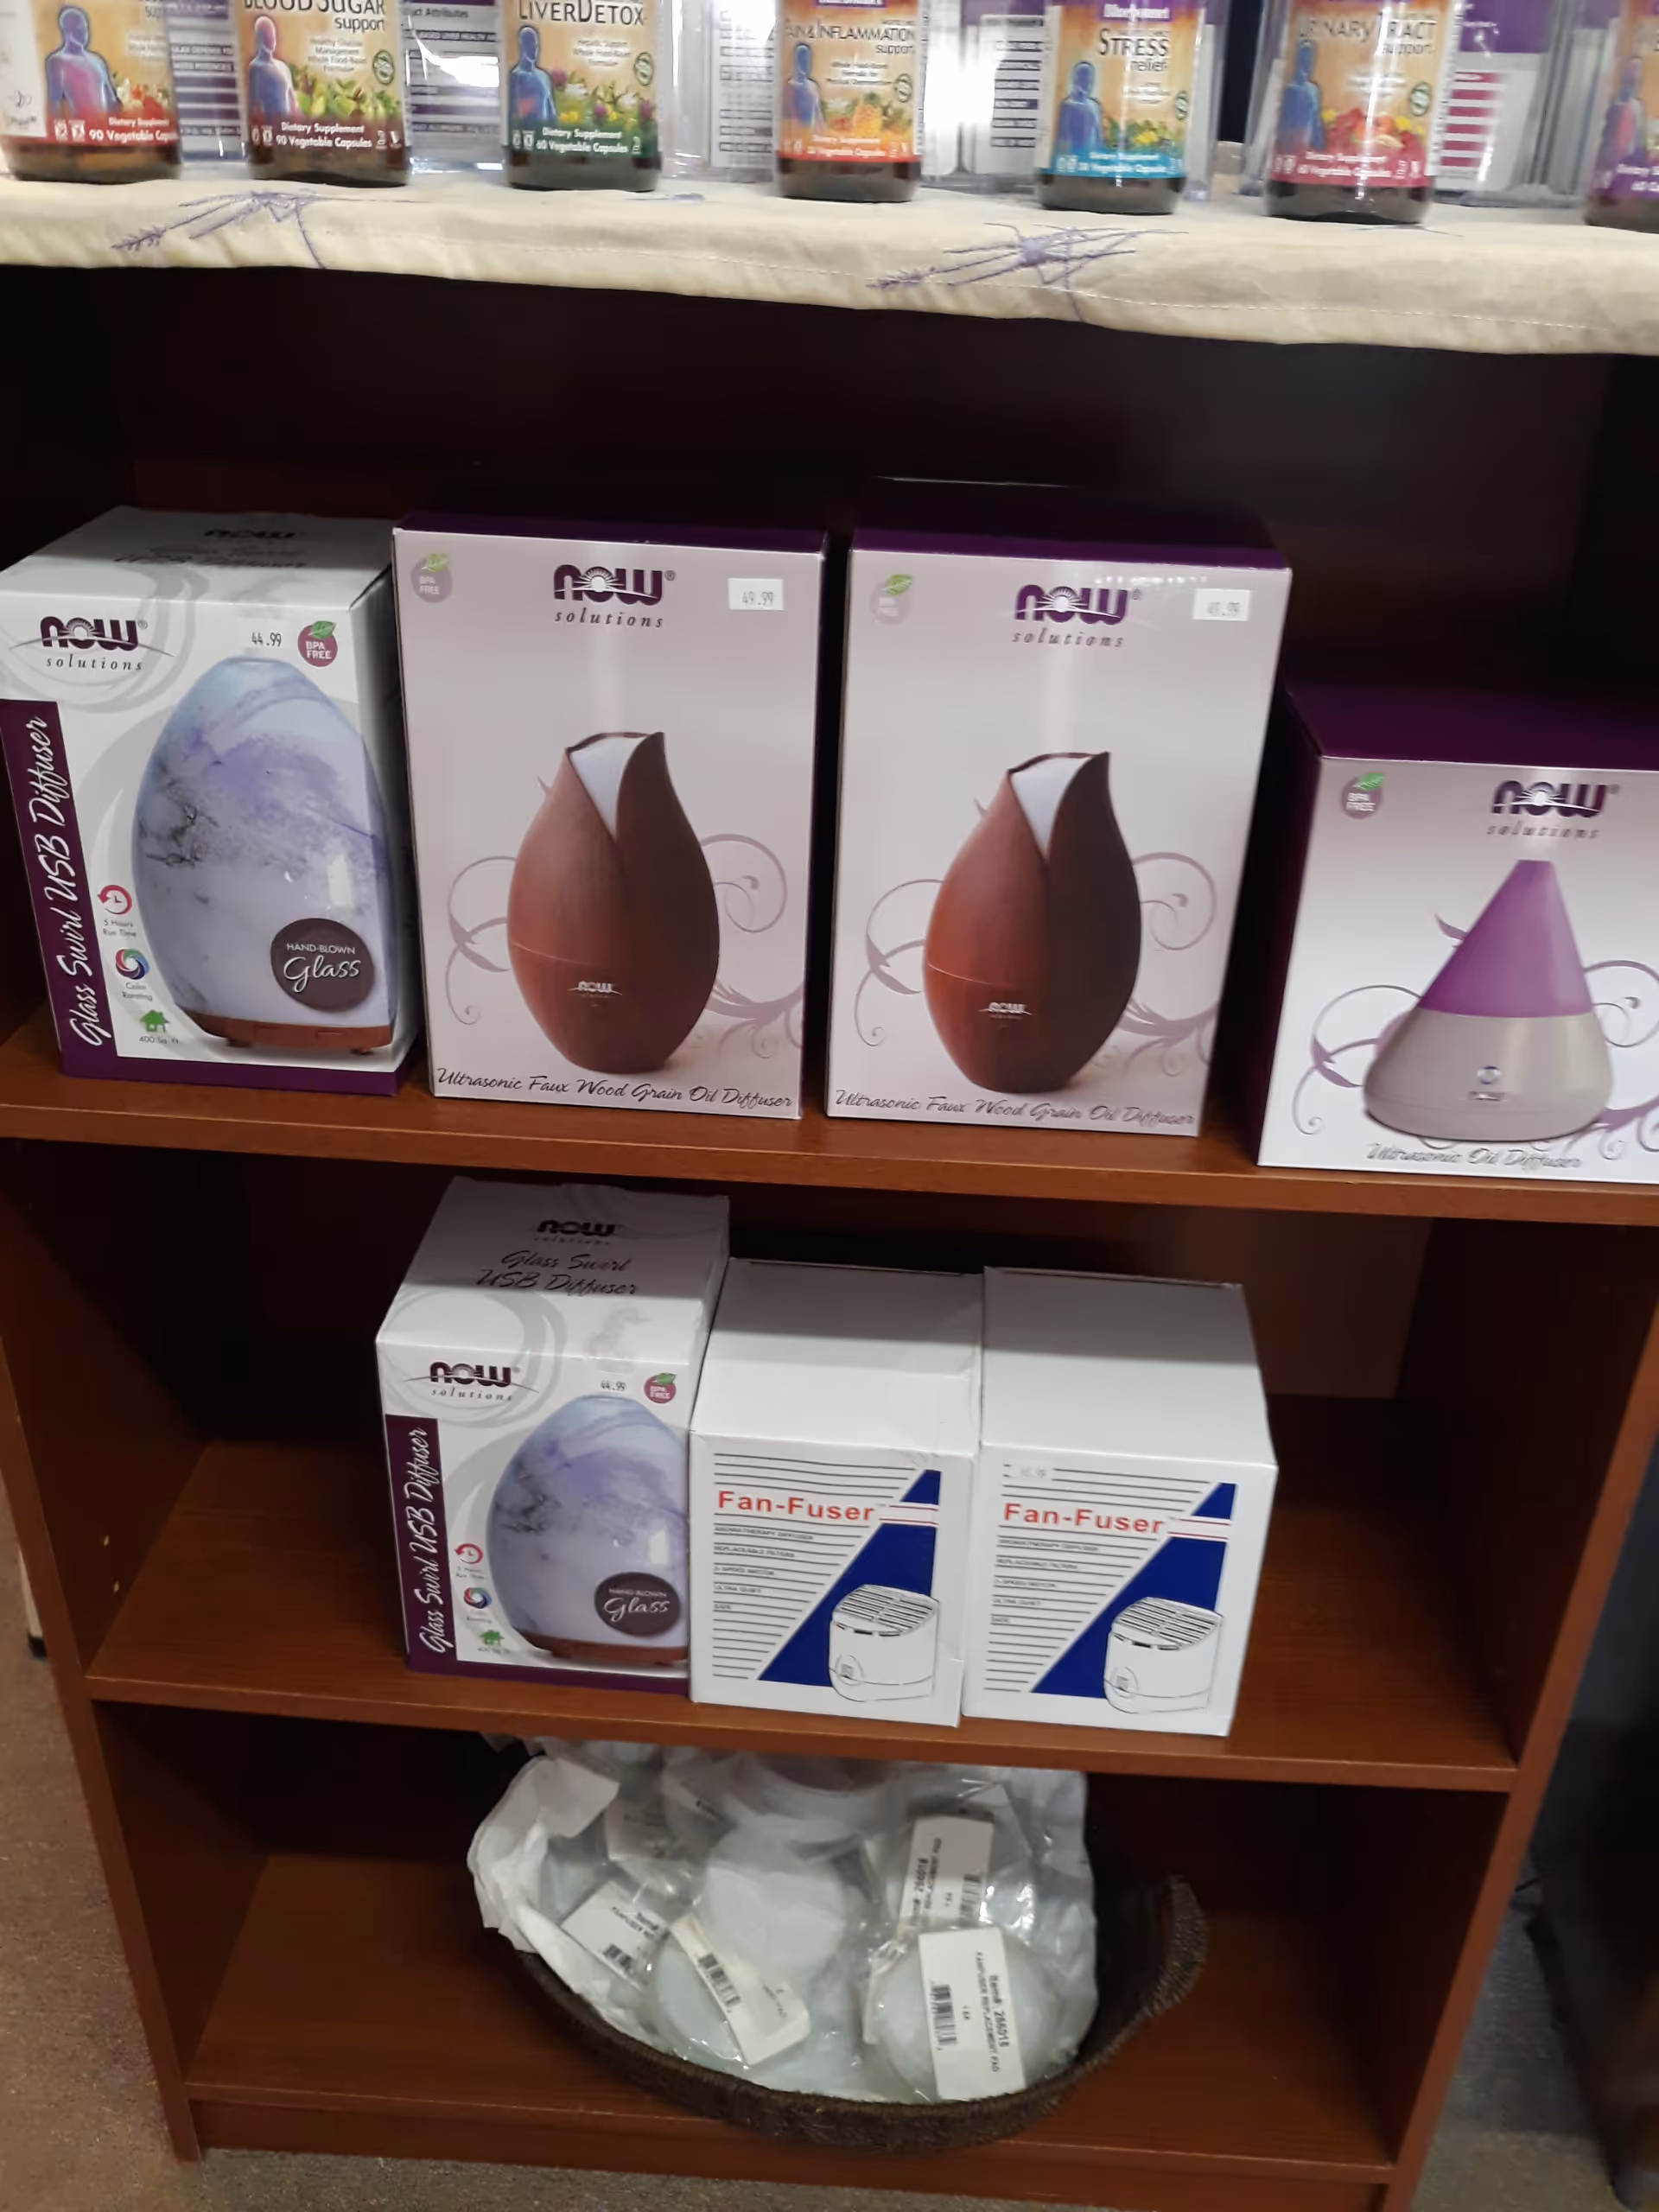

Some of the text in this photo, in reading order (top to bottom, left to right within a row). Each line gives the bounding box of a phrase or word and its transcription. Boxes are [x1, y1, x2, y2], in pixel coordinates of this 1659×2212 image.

[334, 16, 385, 33] support
[1098, 28, 1169, 55] STRESS
[89, 129, 104, 141] 90
[282, 122, 365, 136] Dietary Supplement
[289, 137, 333, 149] Vegetable
[334, 137, 372, 149] Capsules
[556, 607, 664, 629] solutions
[251, 631, 283, 648] 44.99
[305, 640, 326, 652] BPA
[1012, 627, 1124, 649] solutions
[46, 654, 143, 671] solutions
[306, 650, 333, 661] FREE
[1487, 820, 1599, 840] solutions
[29, 715, 113, 1048] Glass Swirl USB Diffuser
[286, 942, 356, 956] HAND-BLOWN
[283, 956, 362, 994] Glass
[437, 1067, 793, 1109] Ultrasonic Faux Wood Grain Oil Diffuser
[836, 1089, 921, 1110] Ultrasonic
[926, 1095, 968, 1114] Faux
[974, 1098, 1025, 1116] Wood
[1029, 1103, 1083, 1121] Grain
[501, 1250, 633, 1271] Glass Swirl
[476, 1268, 639, 1297] USB Diffuser
[431, 1387, 513, 1402] solutions
[718, 1490, 875, 1522] Fan-Fuser
[1003, 1502, 1165, 1535] Fan-Fuser
[403, 1427, 454, 1654] Glass Swirl USB Diffuser
[603, 1598, 671, 1623] Glass
